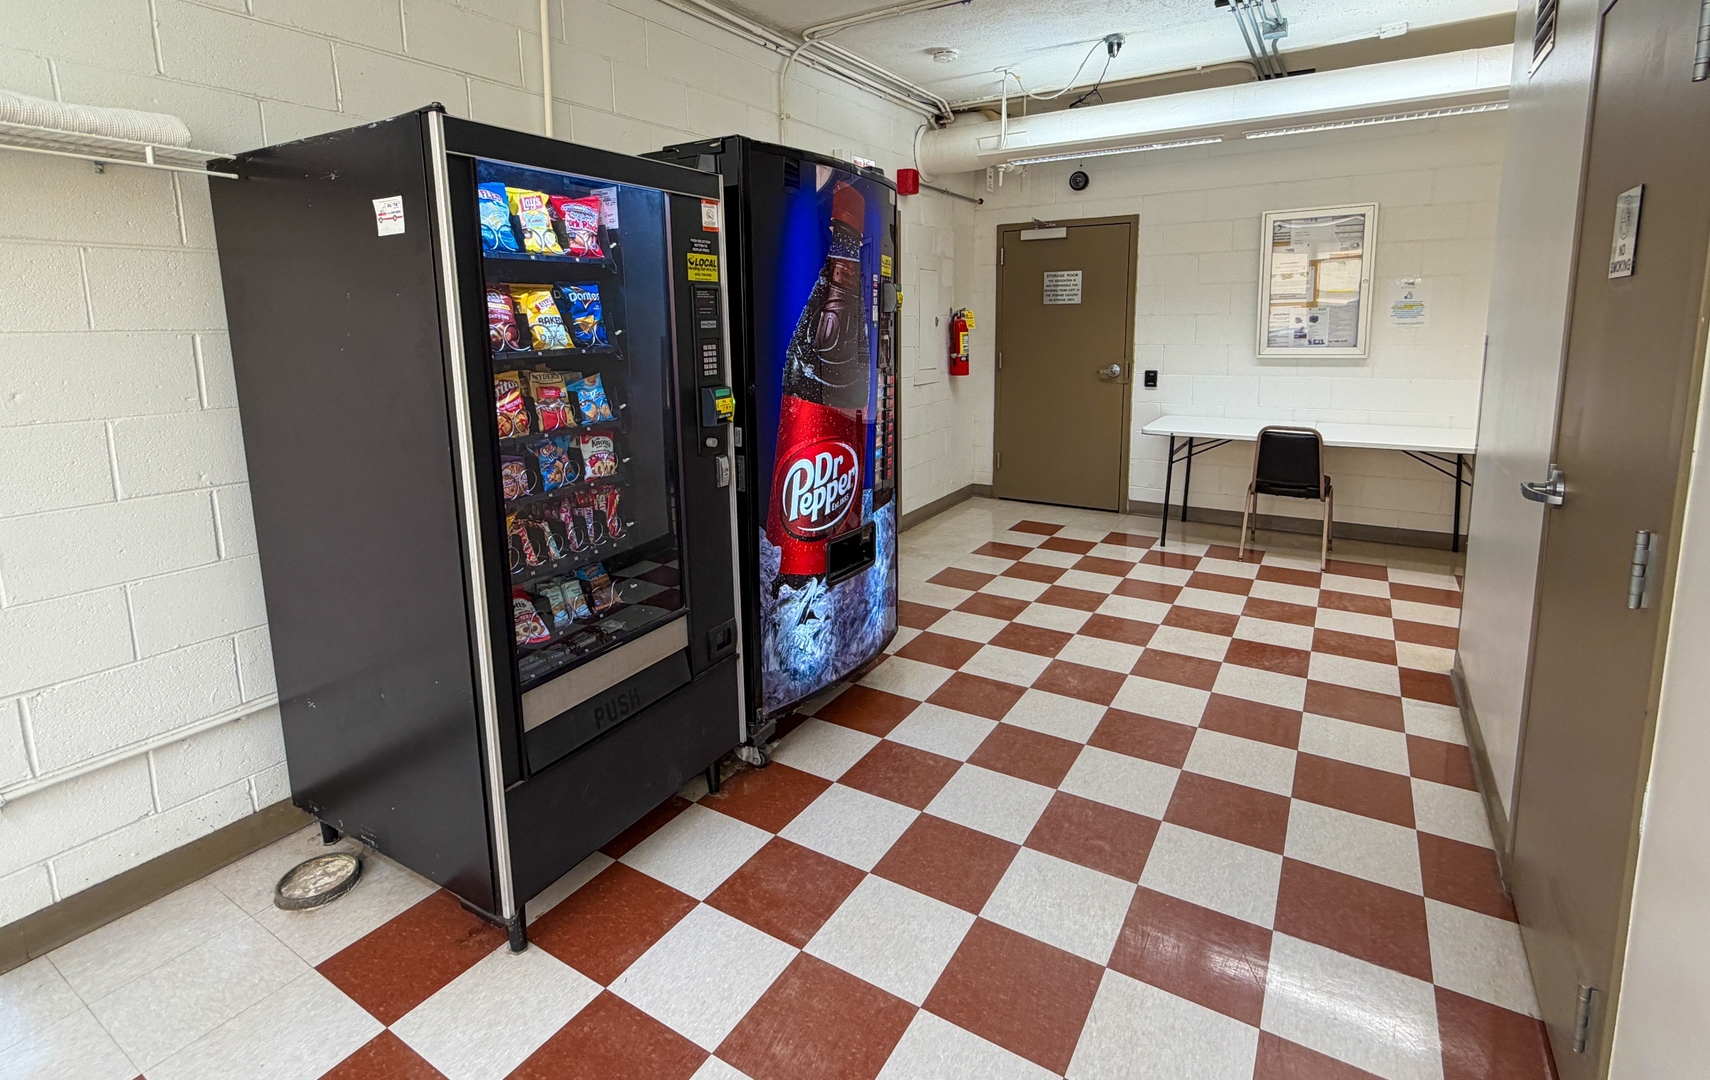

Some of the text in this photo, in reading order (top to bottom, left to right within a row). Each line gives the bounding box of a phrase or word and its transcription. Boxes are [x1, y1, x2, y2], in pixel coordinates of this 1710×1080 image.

[521, 197, 542, 211] Lay's
[1618, 243, 1626, 257] NO
[695, 257, 717, 267] LOCAL
[1610, 258, 1631, 274] SMOKING
[568, 290, 600, 305] Doritos
[814, 452, 844, 488] Dr
[783, 458, 856, 522] Pepper
[593, 686, 642, 731] PUSH
